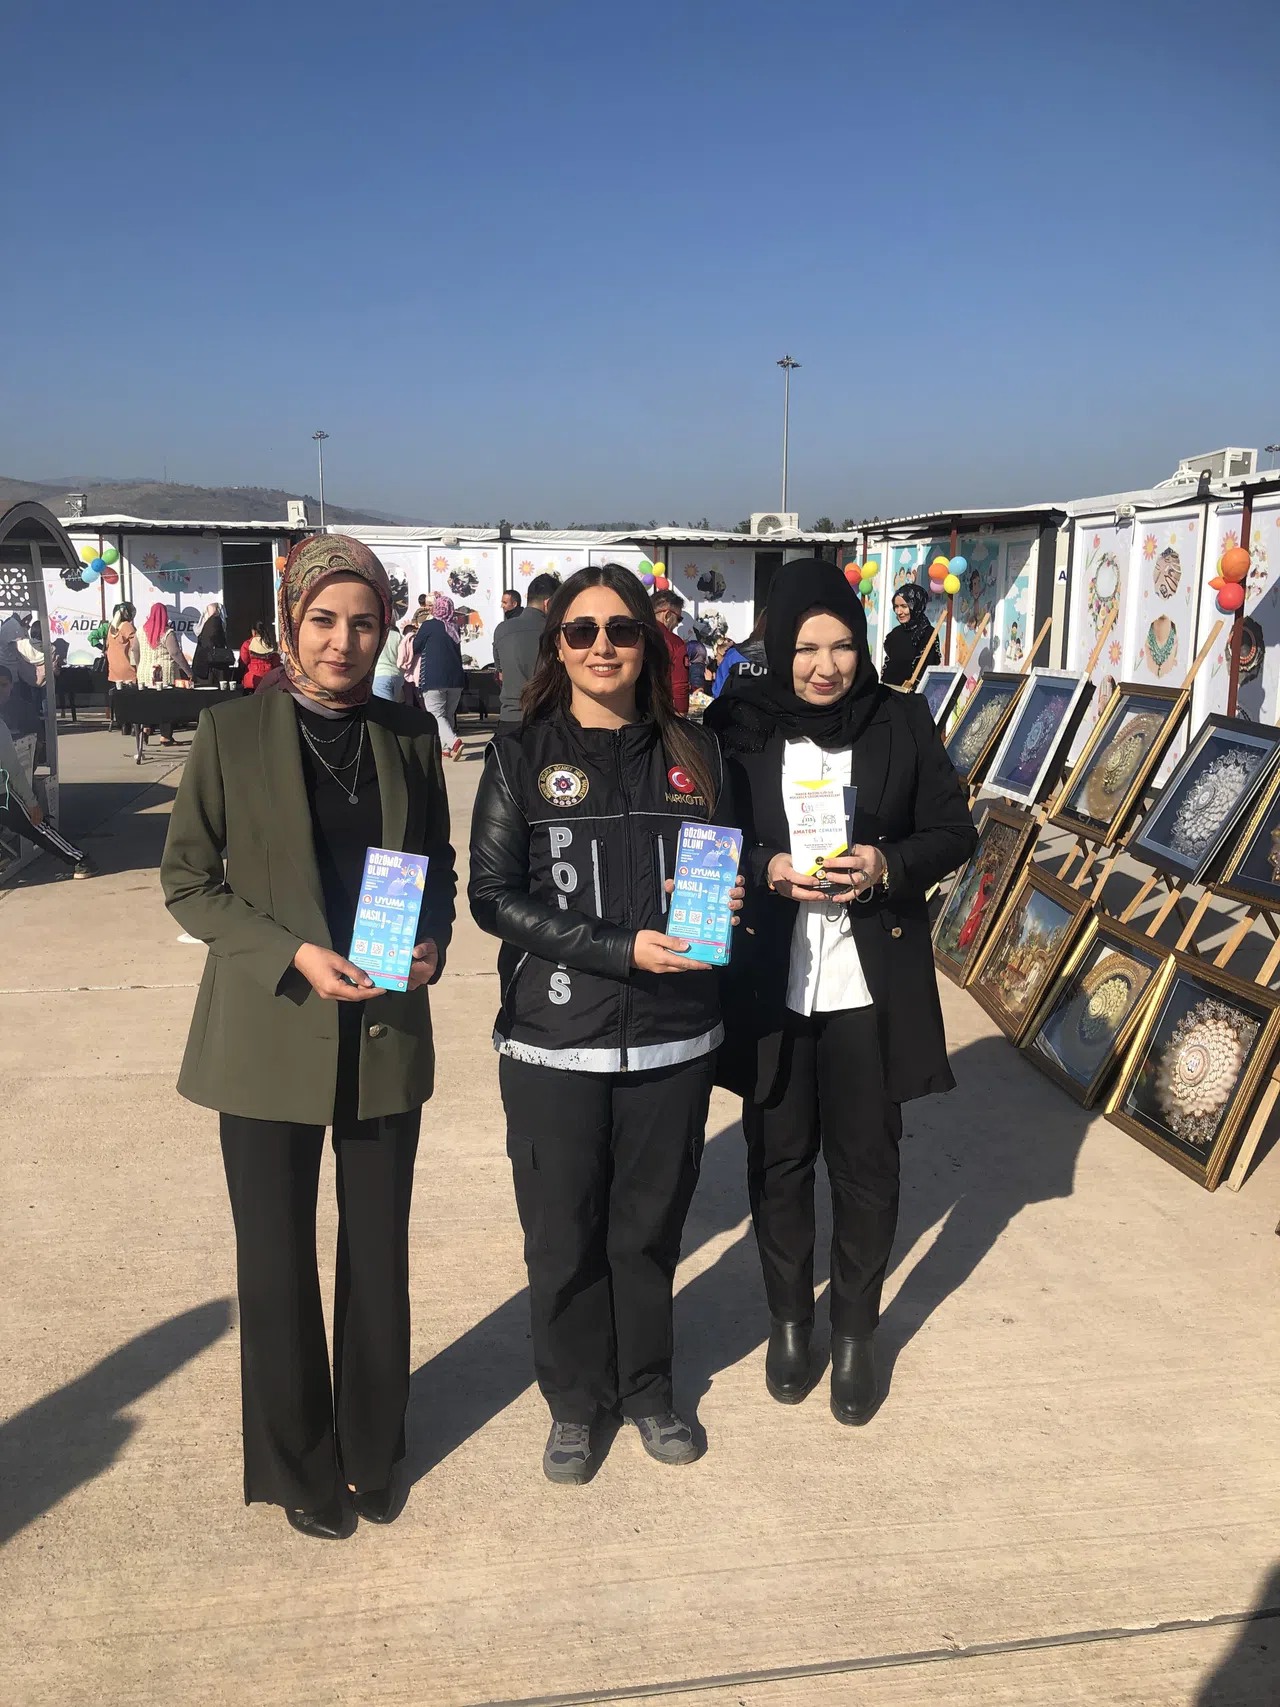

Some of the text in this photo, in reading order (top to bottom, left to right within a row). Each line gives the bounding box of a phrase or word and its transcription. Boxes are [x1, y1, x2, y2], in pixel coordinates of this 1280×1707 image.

[169, 620, 199, 632] ADE
[682, 838, 704, 850] OLUN!
[690, 867, 721, 878] UYUMA
[677, 880, 699, 892] NASIL
[374, 896, 405, 908] UYUMA
[548, 826, 578, 1005] POS
